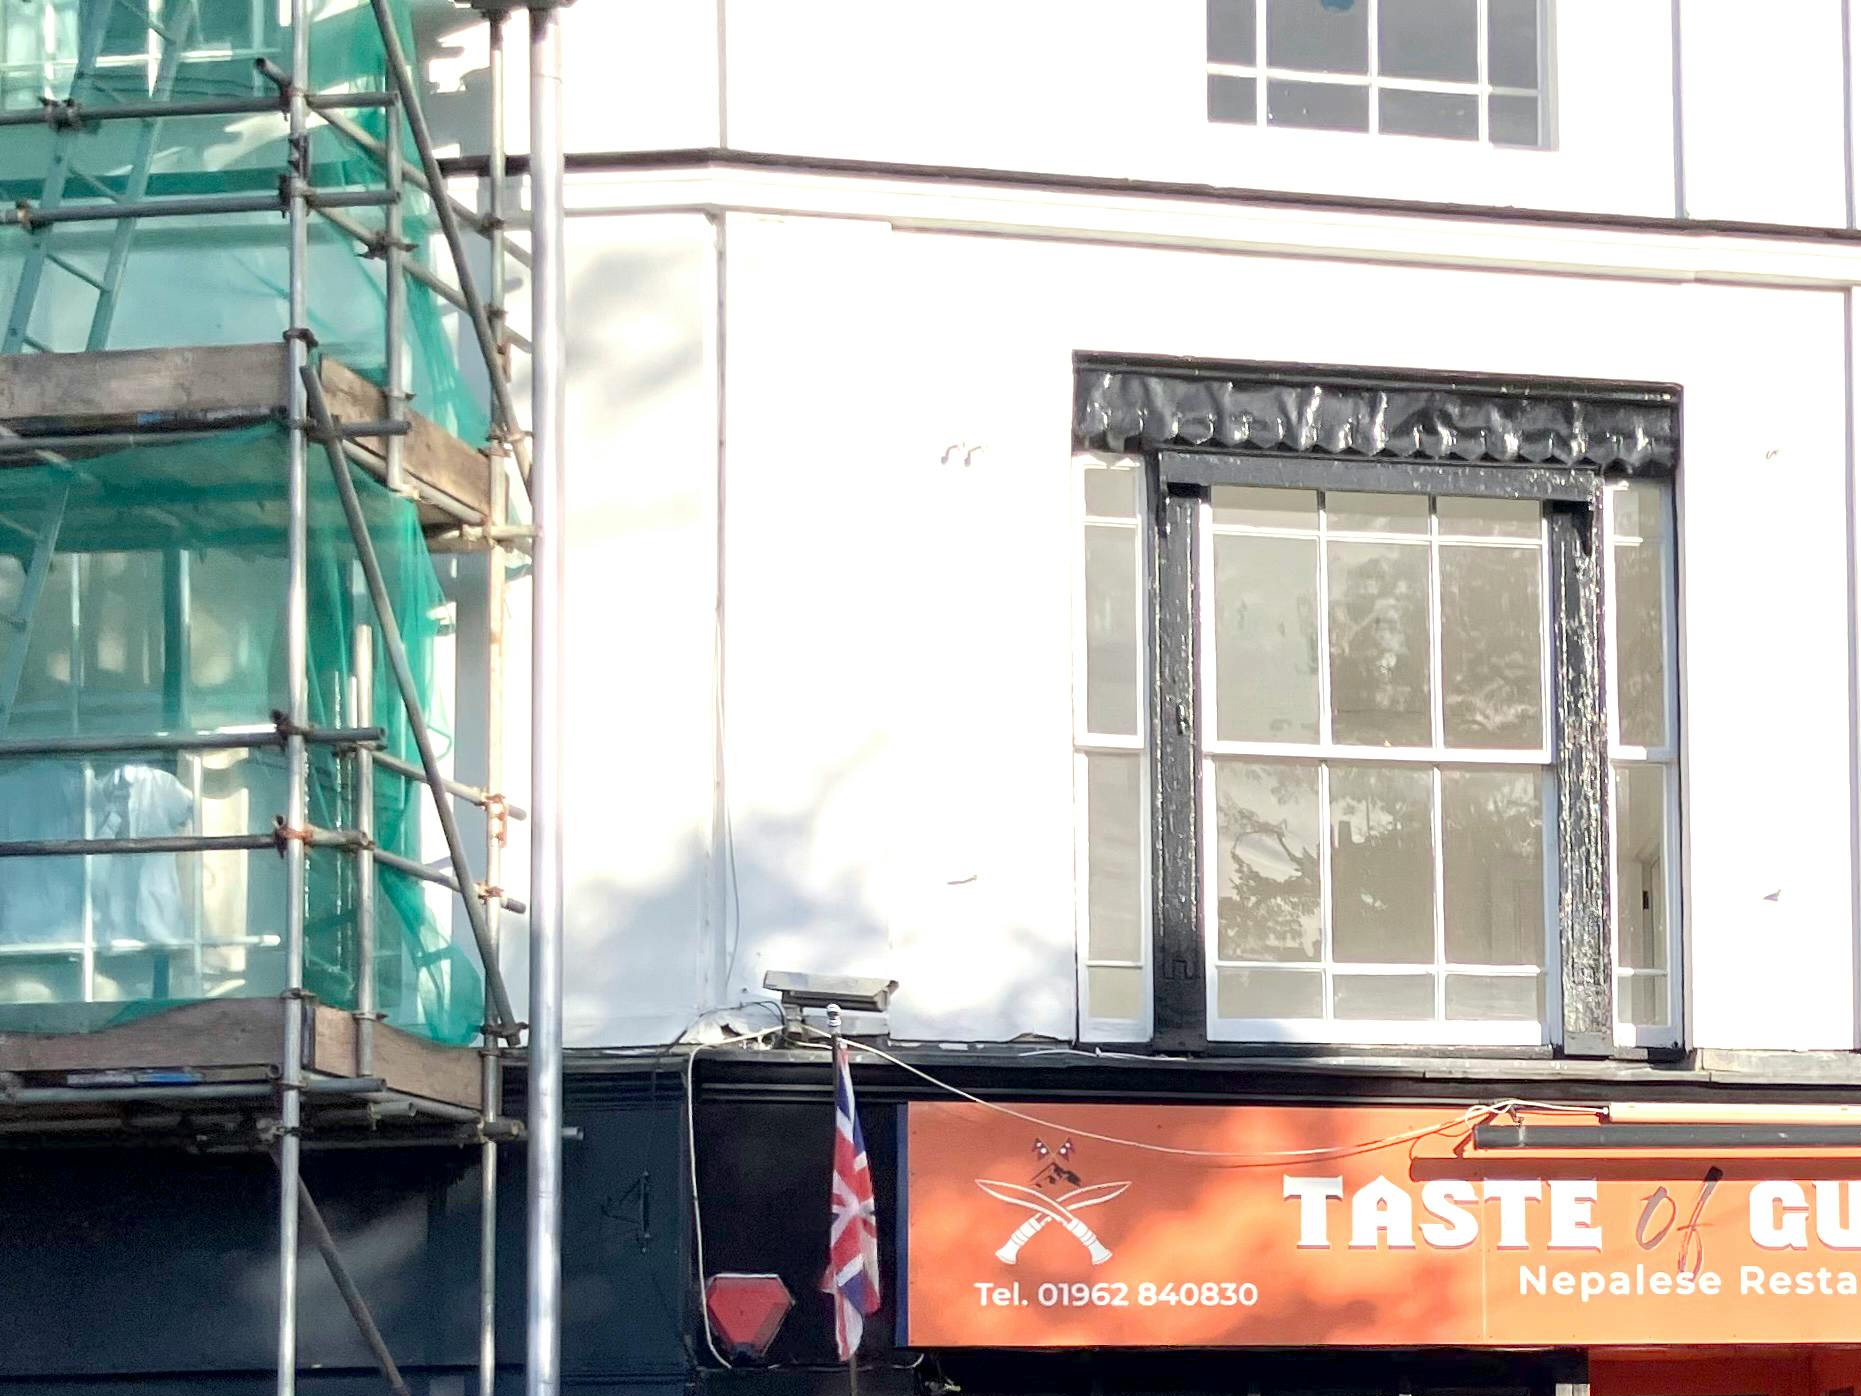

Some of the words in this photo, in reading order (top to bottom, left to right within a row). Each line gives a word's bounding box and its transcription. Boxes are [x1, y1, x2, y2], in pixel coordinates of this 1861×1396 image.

[1283, 1175, 1603, 1251] TASTE
[1636, 1166, 1723, 1283] of
[974, 1282, 1029, 1306] Tel.
[1037, 1282, 1128, 1307] 01962
[1138, 1282, 1259, 1307] 840830
[1518, 1264, 1722, 1302] Nepalese
